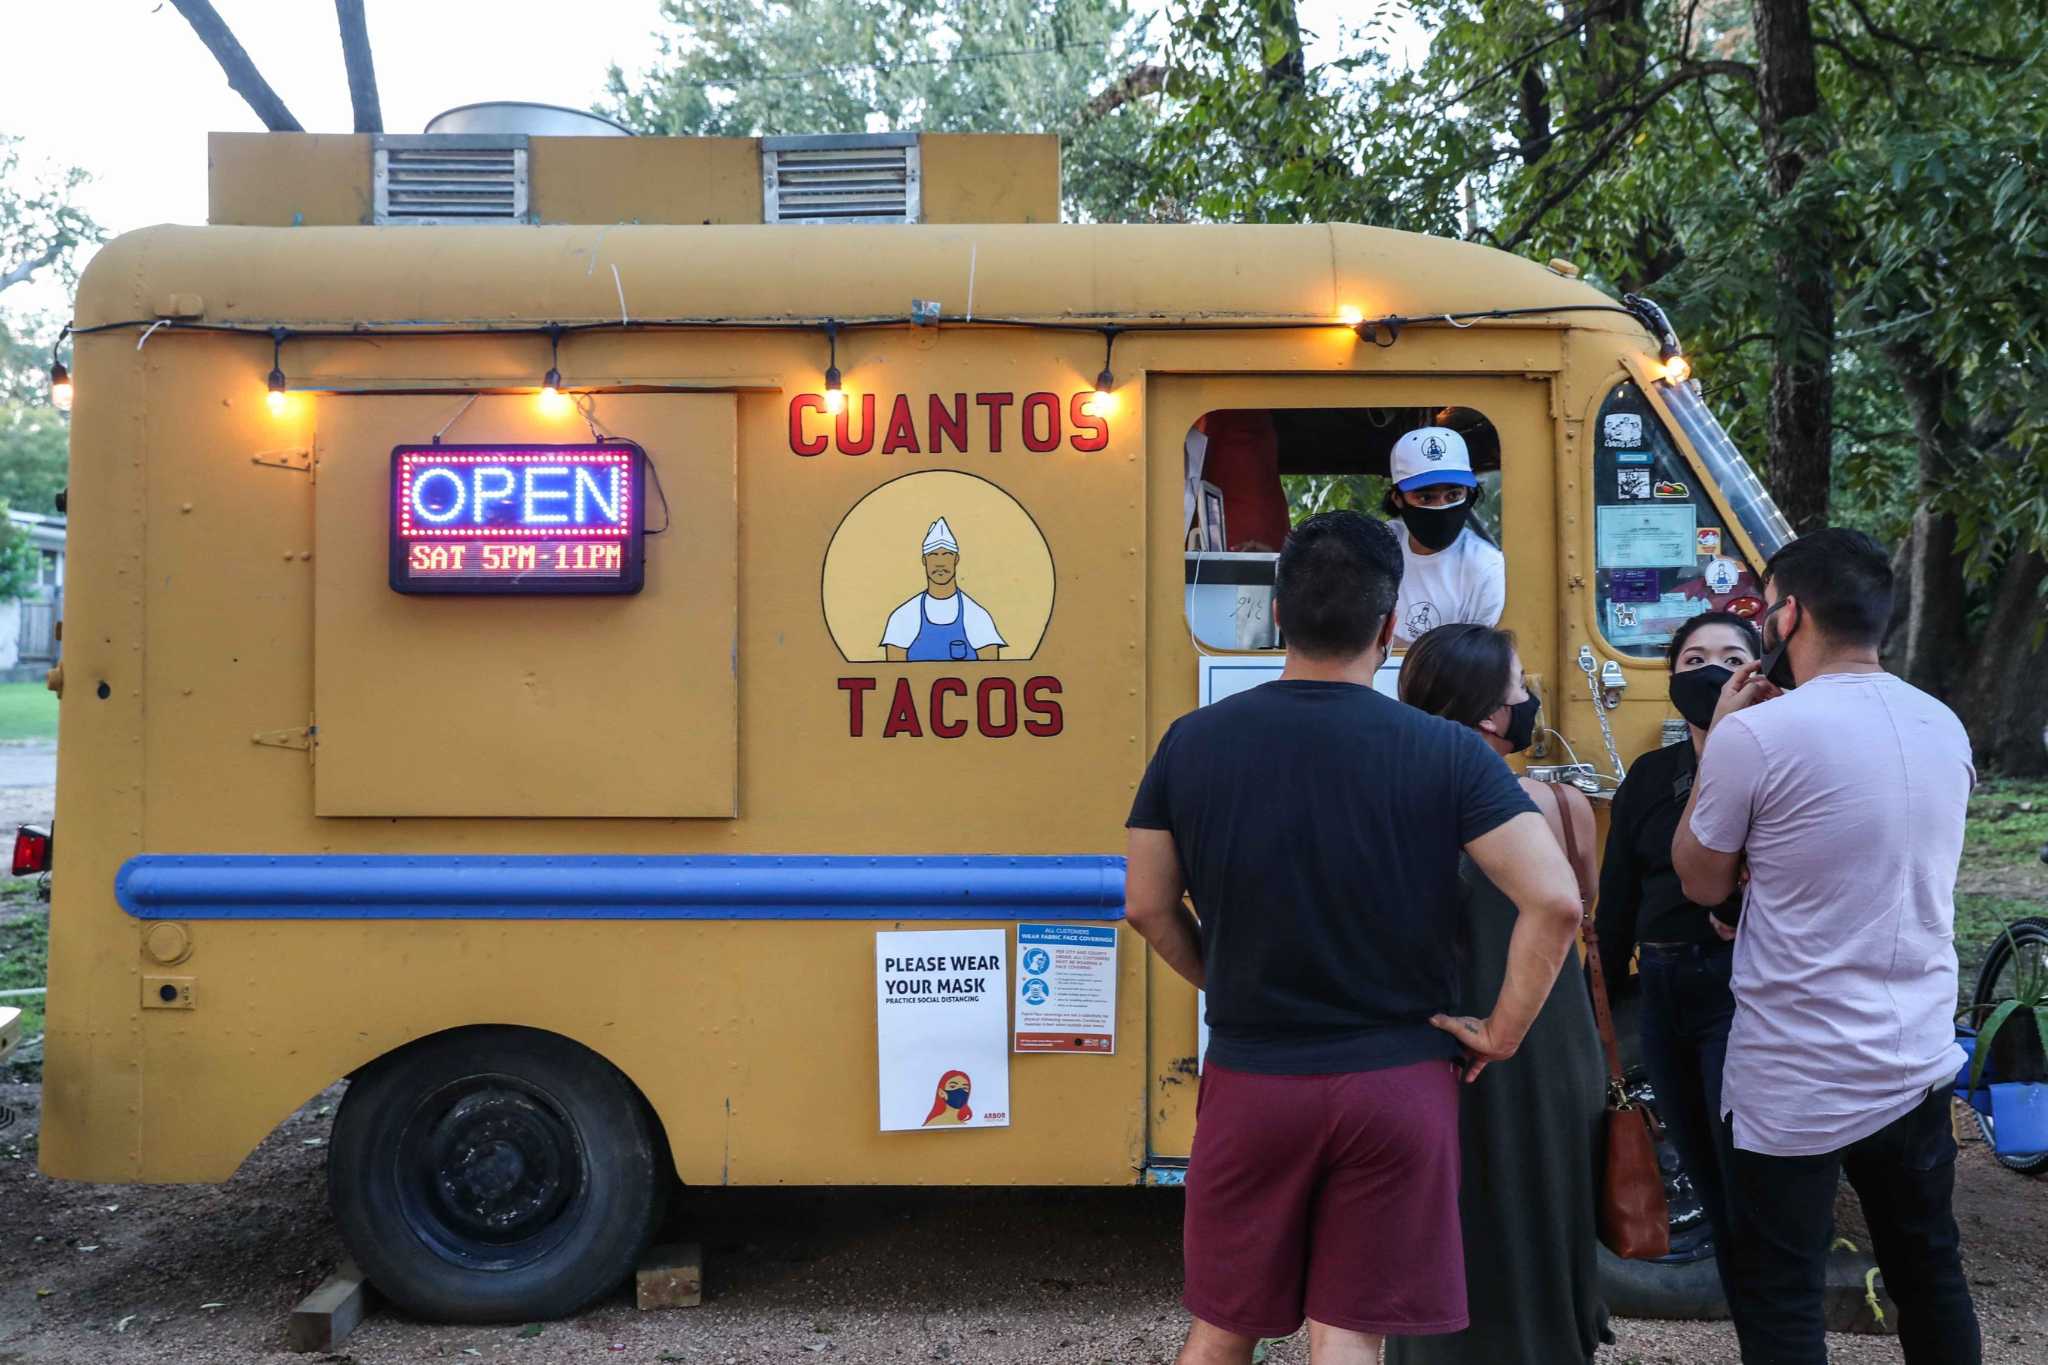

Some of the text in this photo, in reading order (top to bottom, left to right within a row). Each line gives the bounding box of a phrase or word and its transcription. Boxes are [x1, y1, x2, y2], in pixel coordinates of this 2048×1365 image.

[789, 391, 1110, 457] CUANTOS
[411, 466, 620, 523] OPEN
[412, 544, 621, 570] SAT 5PM-11PM
[837, 675, 1064, 738] TACOS
[885, 955, 1000, 973] PLEASE WEAR
[884, 977, 986, 995] YOUR MASK
[941, 995, 980, 1003] DISTANCING
